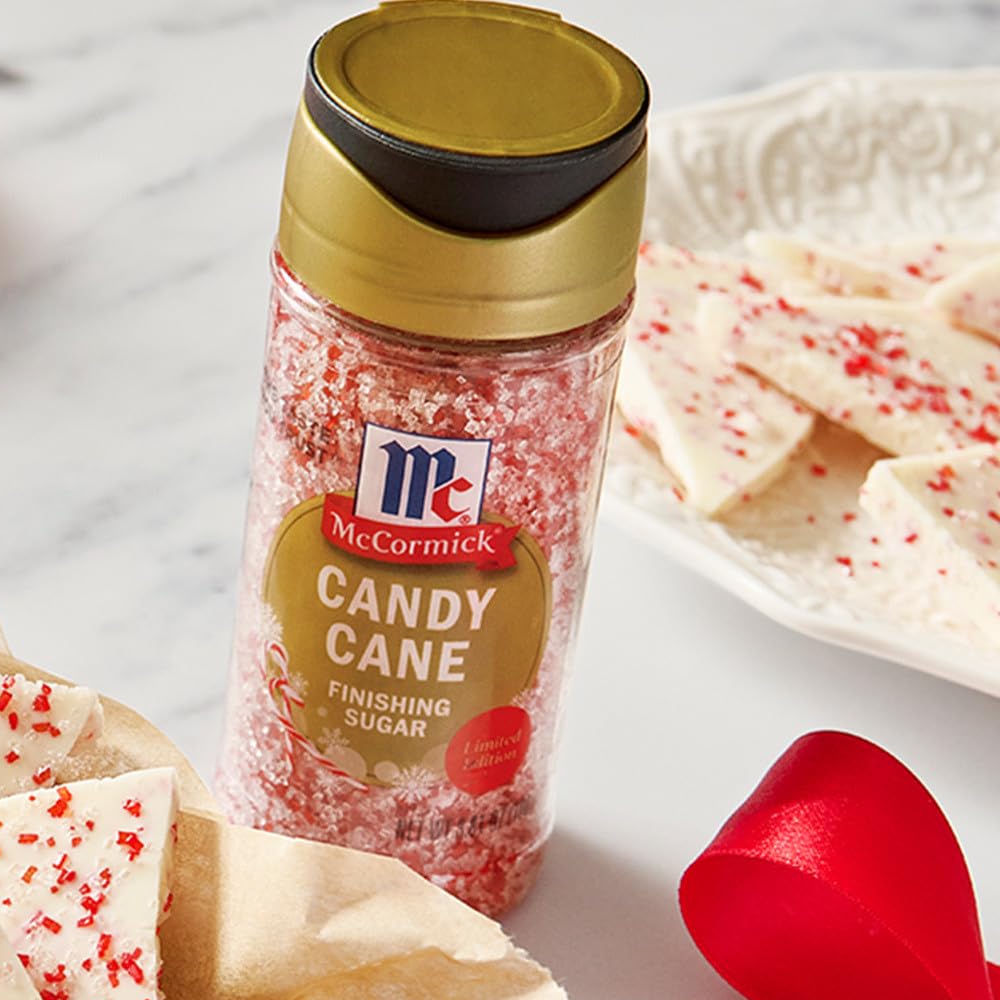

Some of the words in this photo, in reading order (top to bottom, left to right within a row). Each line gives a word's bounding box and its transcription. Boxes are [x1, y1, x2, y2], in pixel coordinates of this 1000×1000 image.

[330, 511, 496, 556] McCormick
[317, 565, 497, 631] CANDY
[325, 623, 470, 683] CANE
[328, 680, 452, 718] FINISHING
[344, 709, 428, 738] SUGAR
[463, 728, 523, 755] Limited
